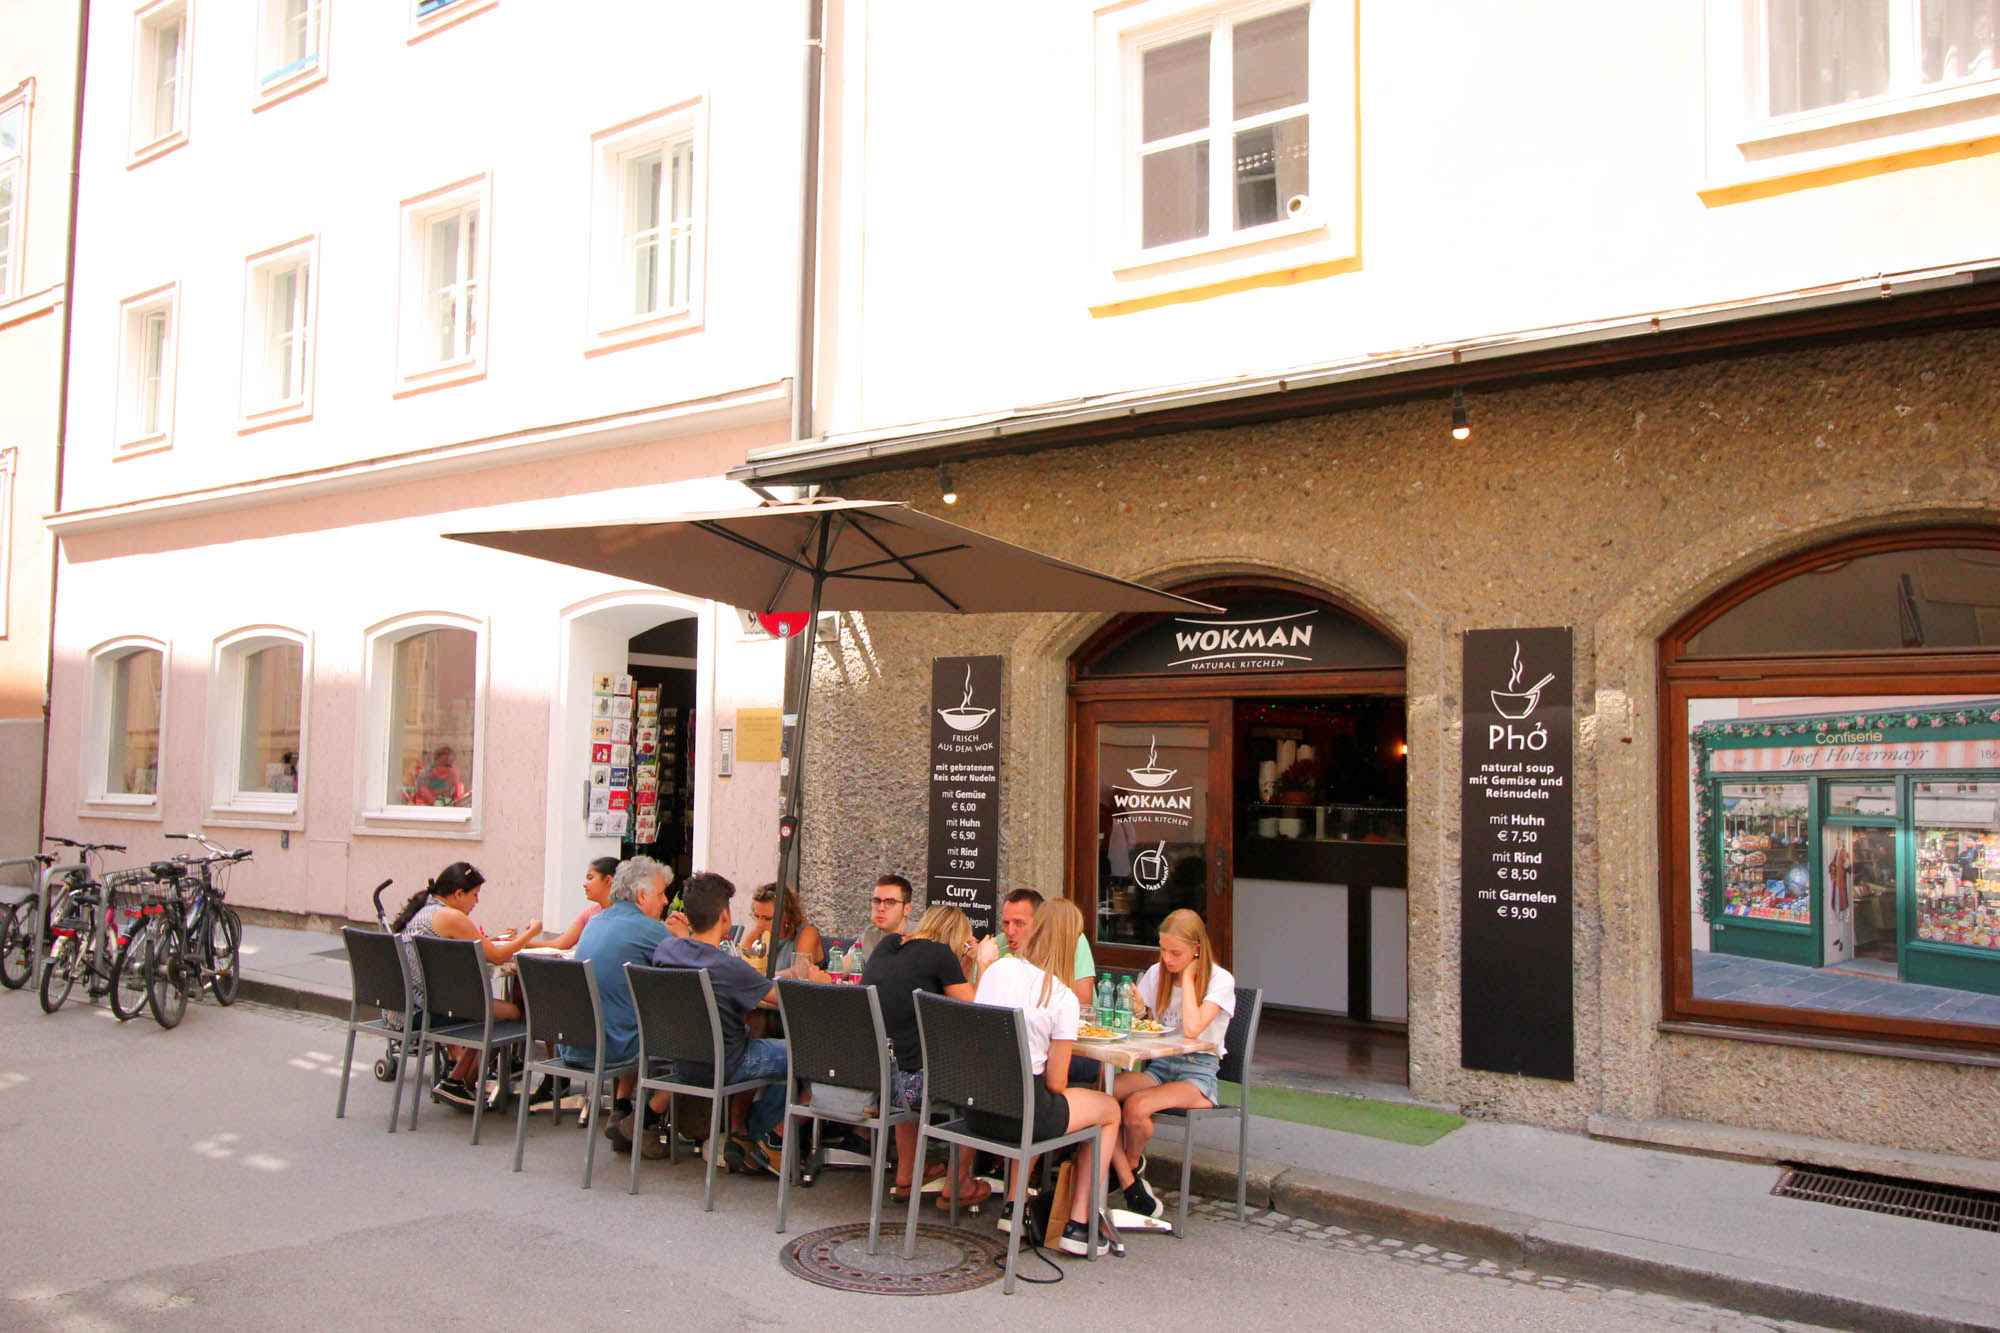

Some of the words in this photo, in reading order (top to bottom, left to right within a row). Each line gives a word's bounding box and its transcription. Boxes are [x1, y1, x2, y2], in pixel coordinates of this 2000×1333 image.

[1175, 624, 1313, 652] WOKMAN
[1191, 660, 1236, 670] NATURAL
[1240, 659, 1285, 669] KITCHEN
[952, 734, 979, 742] FRISCH
[1815, 730, 1883, 745] Confiserie
[937, 742, 953, 752] AUS
[955, 745, 973, 753] DEM
[974, 742, 994, 752] WOK
[1783, 750, 1819, 769] Josef
[1825, 746, 1929, 766] Holzermayr
[1980, 749, 2000, 761] 186
[935, 763, 948, 771] mit
[949, 763, 994, 773] gebratenem
[1481, 762, 1522, 773] natural
[1525, 764, 1554, 775] soup
[933, 773, 949, 781] Reis
[950, 773, 967, 782] oder
[969, 774, 996, 782] Nudeln
[1469, 774, 1488, 785] mit
[1491, 775, 1537, 786] Gemüse
[1540, 776, 1563, 786] und
[942, 790, 954, 799] mit
[955, 789, 986, 799] Gemüse
[1485, 788, 1549, 799] Reisnudeln
[951, 802, 958, 811] €
[959, 803, 977, 812] 6,00
[1113, 794, 1192, 810] WOKMAN
[946, 818, 958, 827] mit
[959, 818, 981, 828] Huhn
[1117, 816, 1152, 824] NATURAL
[1154, 816, 1189, 827] KITCHEN
[1489, 813, 1508, 825] mit
[1511, 814, 1545, 826] Huhn
[950, 831, 958, 840] €
[959, 831, 976, 841] 6,90
[1497, 830, 1508, 841] €
[1511, 831, 1538, 843] 7,50
[947, 847, 959, 856] mit
[960, 847, 978, 857] Rind
[1492, 851, 1511, 862] mit
[1513, 852, 1542, 864] Rind
[949, 859, 957, 868] €
[958, 860, 975, 870] 7,90
[1145, 883, 1162, 891] TAKE
[1160, 865, 1169, 886] AWAY
[1496, 867, 1508, 879] €
[1510, 868, 1538, 881] 8,50
[946, 884, 977, 901] Curry
[1478, 888, 1497, 900] mit
[1499, 889, 1557, 903] Garnelen
[972, 902, 992, 911] Mango
[1496, 905, 1508, 917] €
[1510, 906, 1538, 920] 9,90
